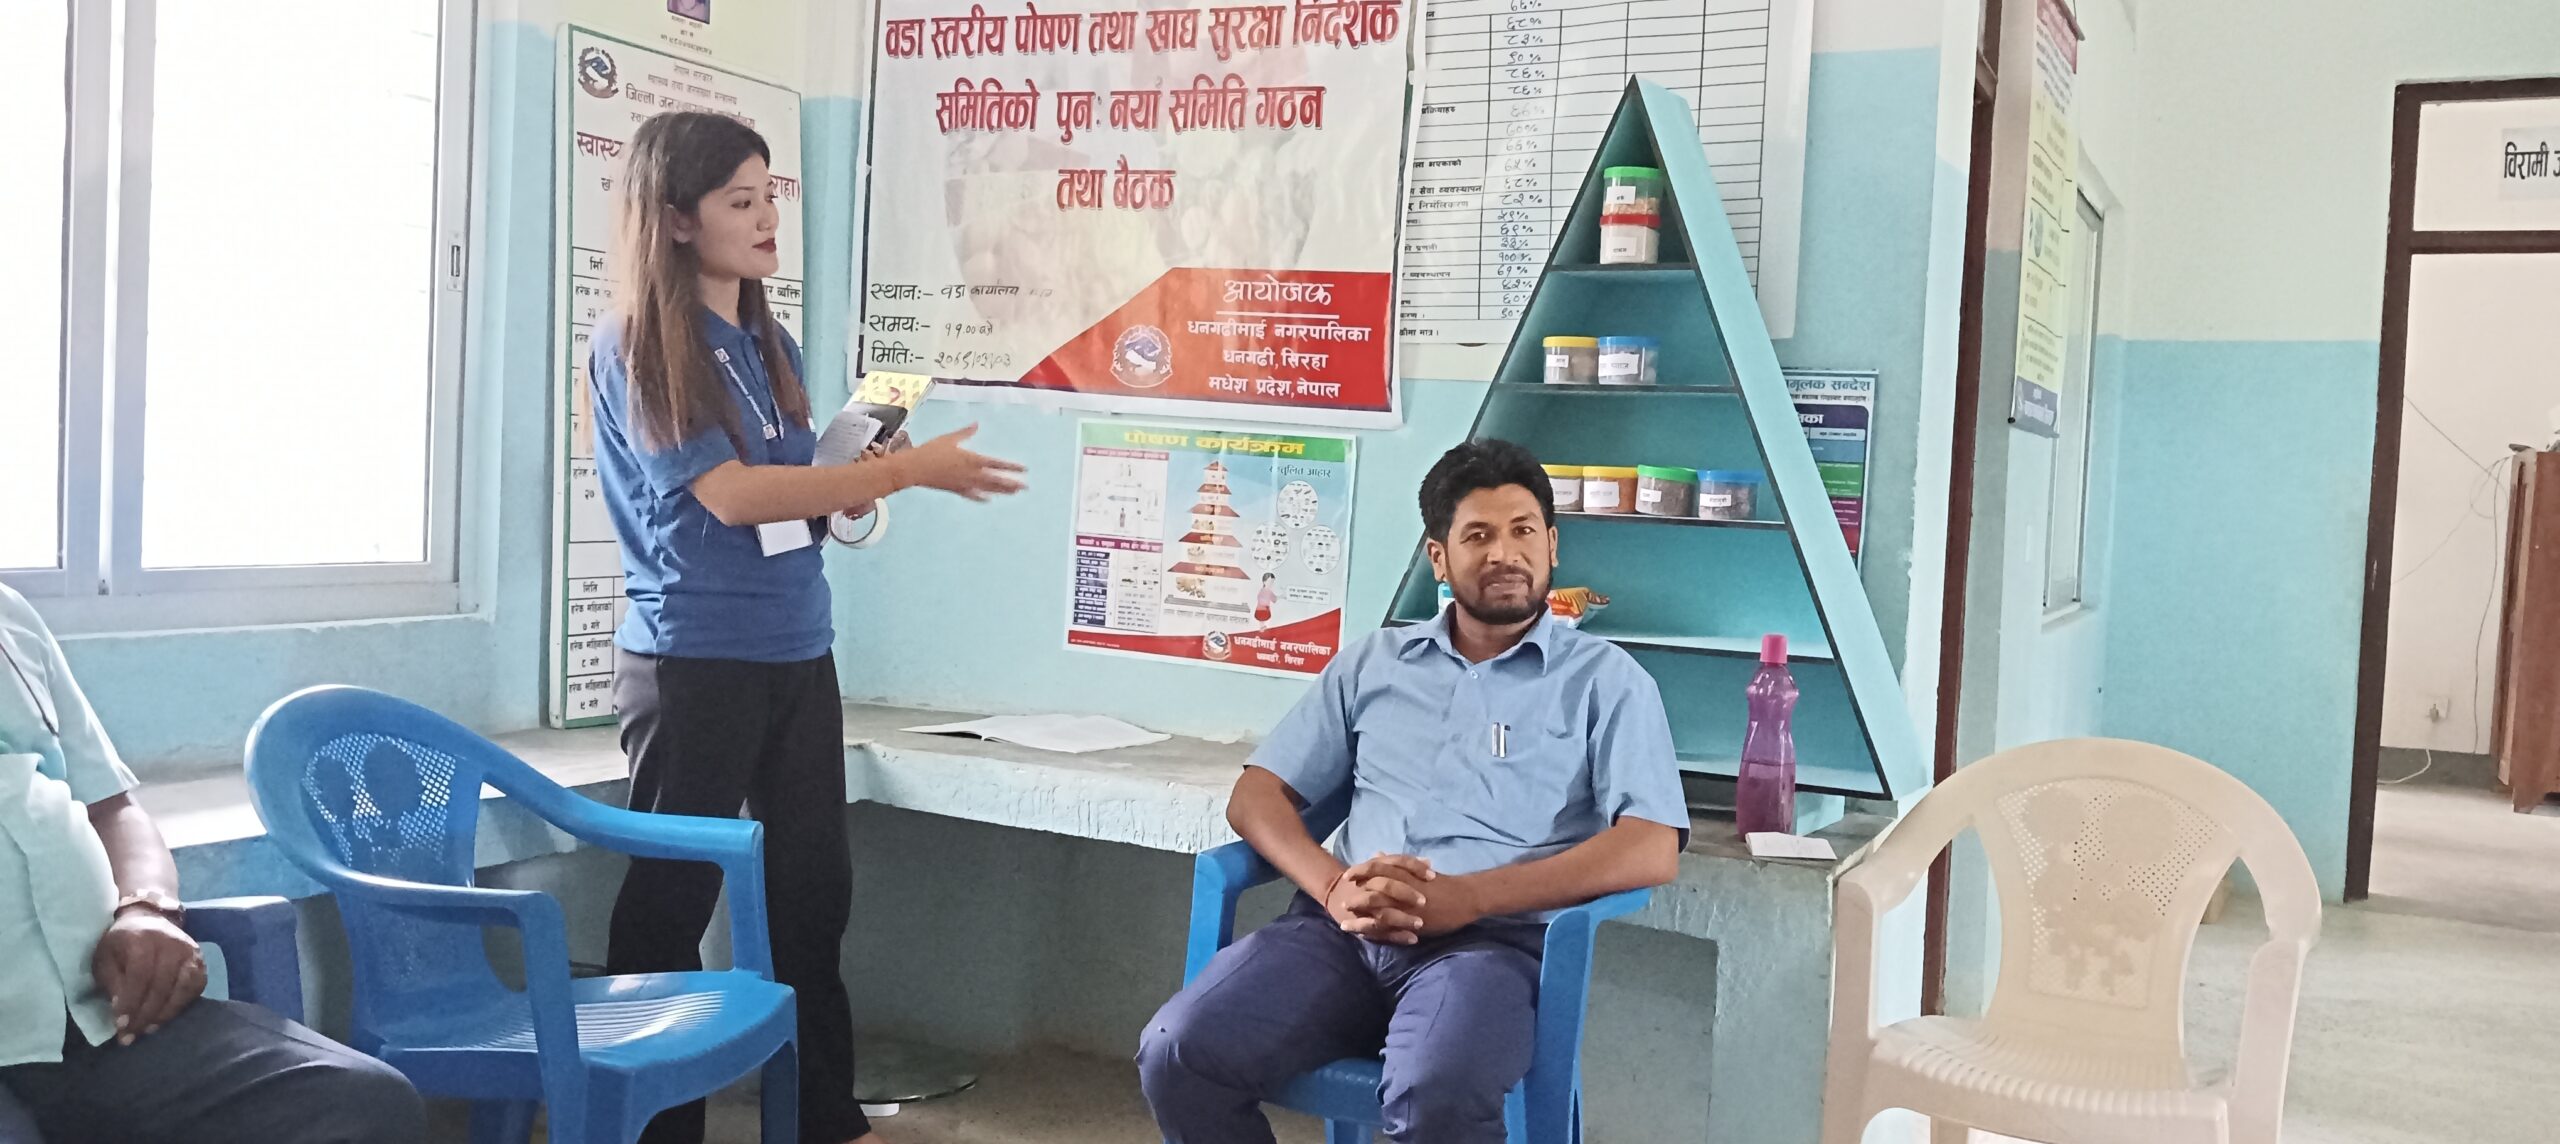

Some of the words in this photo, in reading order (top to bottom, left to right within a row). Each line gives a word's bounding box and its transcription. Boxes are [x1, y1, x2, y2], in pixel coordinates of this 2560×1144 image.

[886, 18, 926, 59] वडा
[931, 3, 1008, 60] स्तरीय
[1015, 1, 1082, 56] पोषण
[1088, 11, 1138, 57] तथा
[1146, 8, 1201, 53] खाद्य
[1208, 5, 1287, 62] सुरक्षा
[625, 83, 656, 106] जिल्ला
[936, 77, 1040, 134] समितिको
[1169, 73, 1248, 135] समिति
[1255, 86, 1327, 131] गठन
[2504, 141, 2550, 180] विरामी
[1056, 168, 1108, 211] तथा
[1113, 154, 1177, 211] बैठक
[940, 283, 966, 300] वडा
[1223, 274, 1335, 306] आयोजक
[1187, 318, 1267, 340] धनगढीमाई
[1274, 321, 1372, 342] नगरपालिका
[1208, 373, 1249, 393] मधेश
[1831, 378, 1871, 392] सन्देश
